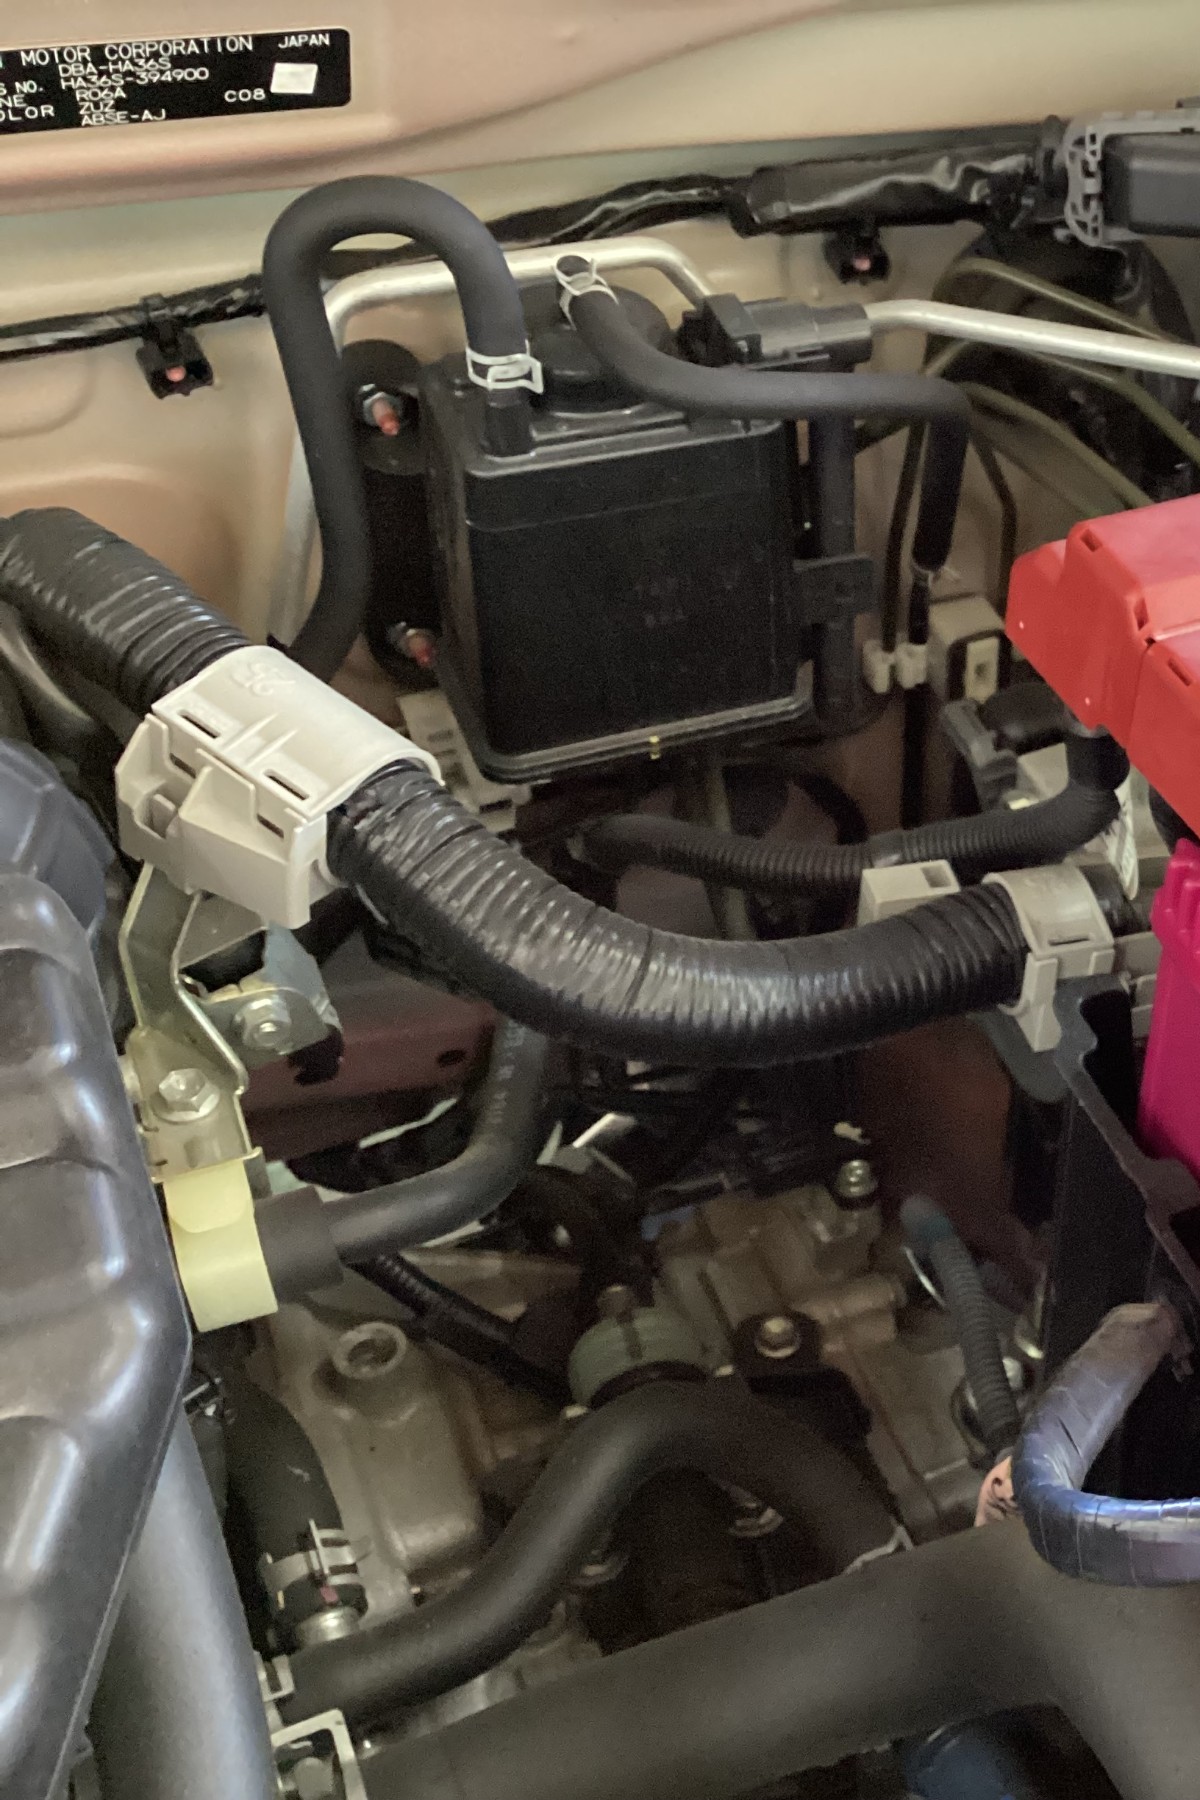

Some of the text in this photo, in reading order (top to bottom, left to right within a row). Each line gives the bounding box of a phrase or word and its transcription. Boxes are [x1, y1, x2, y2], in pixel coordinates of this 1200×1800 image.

[278, 33, 330, 48] JAPAN
[21, 46, 91, 66] MOTOR
[105, 36, 253, 60] CORPORATION
[58, 57, 172, 78] DBA-HA36S
[15, 80, 44, 94] NO.
[61, 67, 209, 90] HA36S-394900
[79, 101, 116, 115] ZUZ
[81, 108, 166, 127] ABSE-AJ
